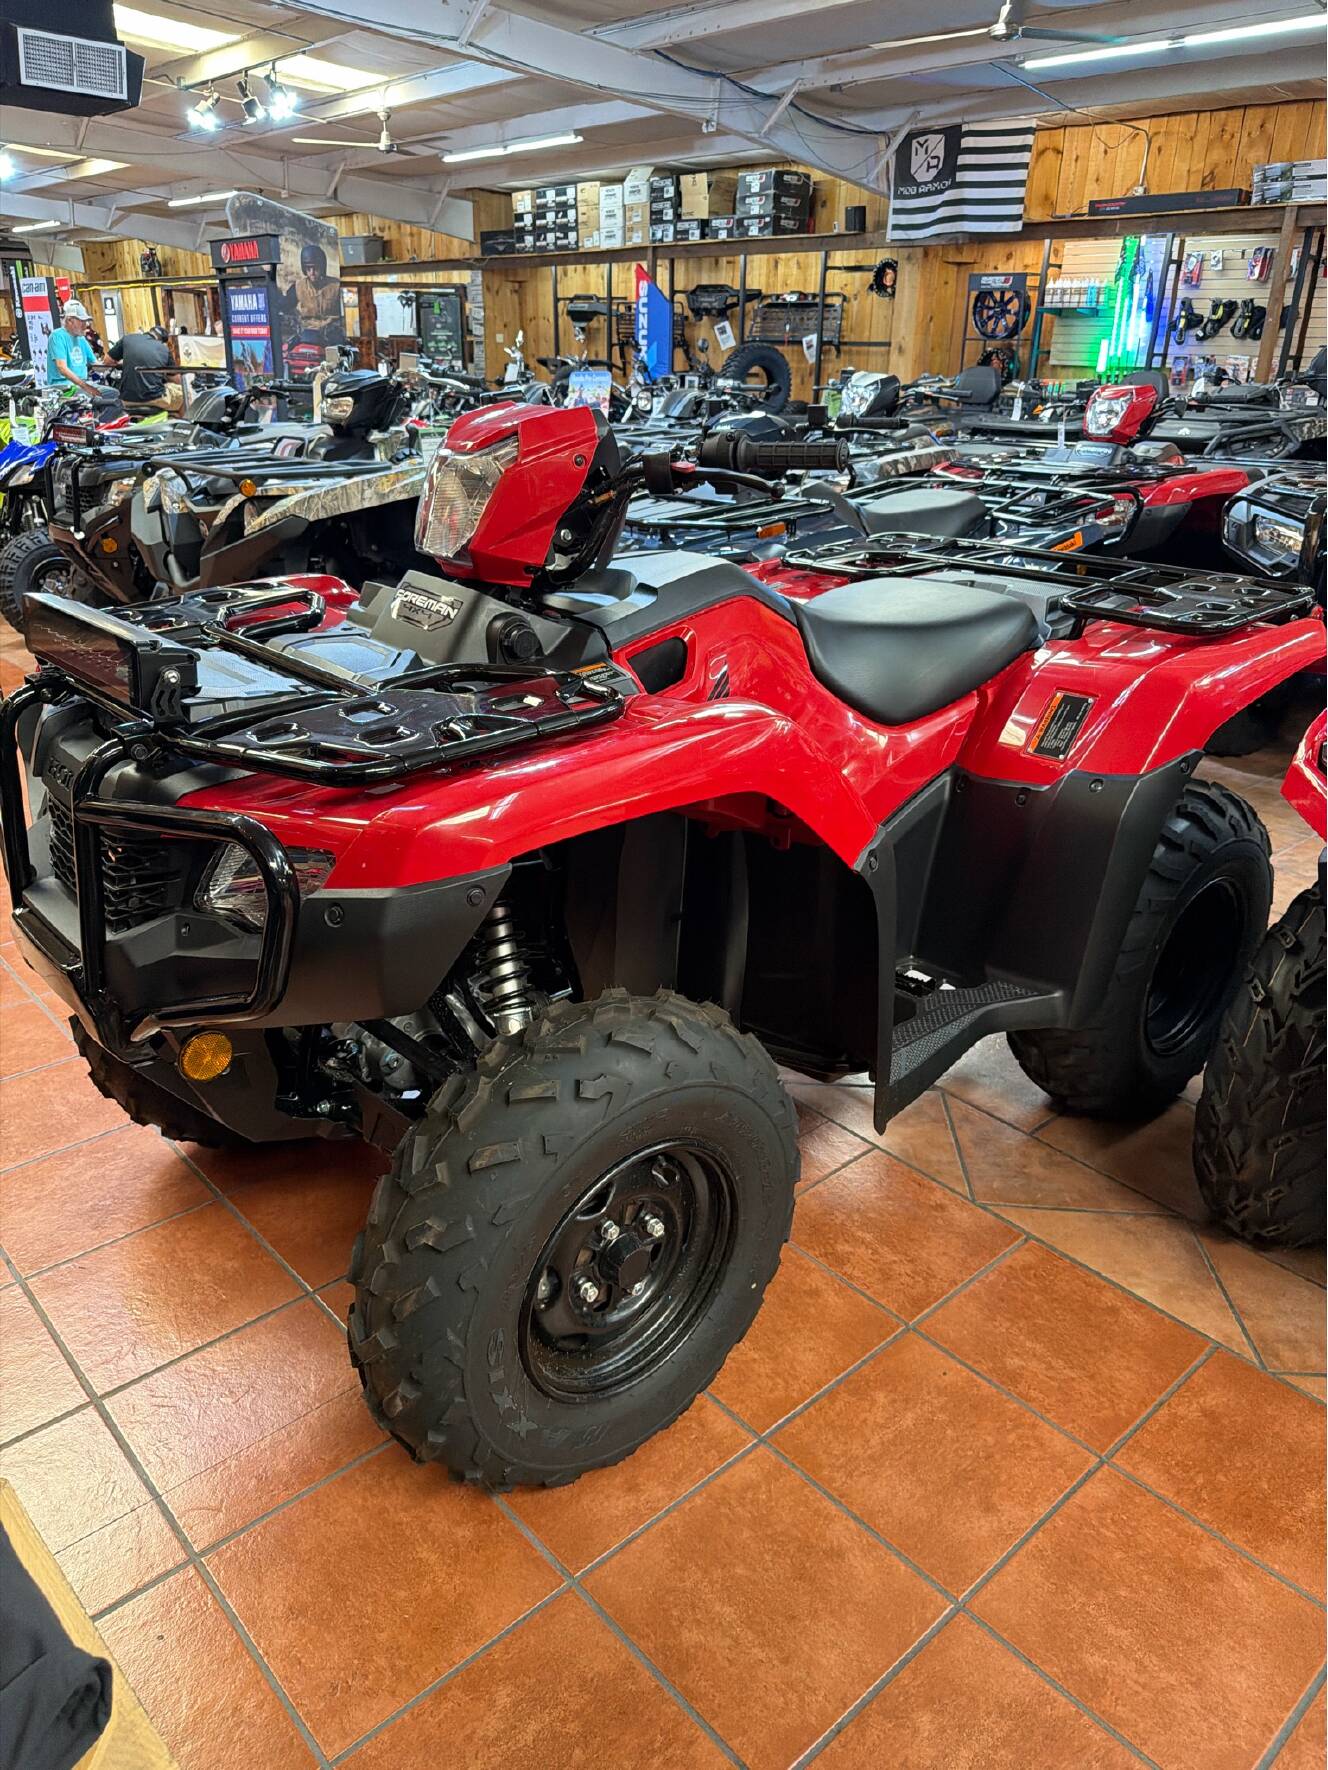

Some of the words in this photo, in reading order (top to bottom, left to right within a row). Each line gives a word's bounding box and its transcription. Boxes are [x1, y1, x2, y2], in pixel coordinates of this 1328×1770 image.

[229, 240, 259, 261] YAMAHA
[230, 293, 258, 311] YAMAHA
[638, 279, 648, 361] SUZUK
[394, 588, 459, 620] FOREMAN
